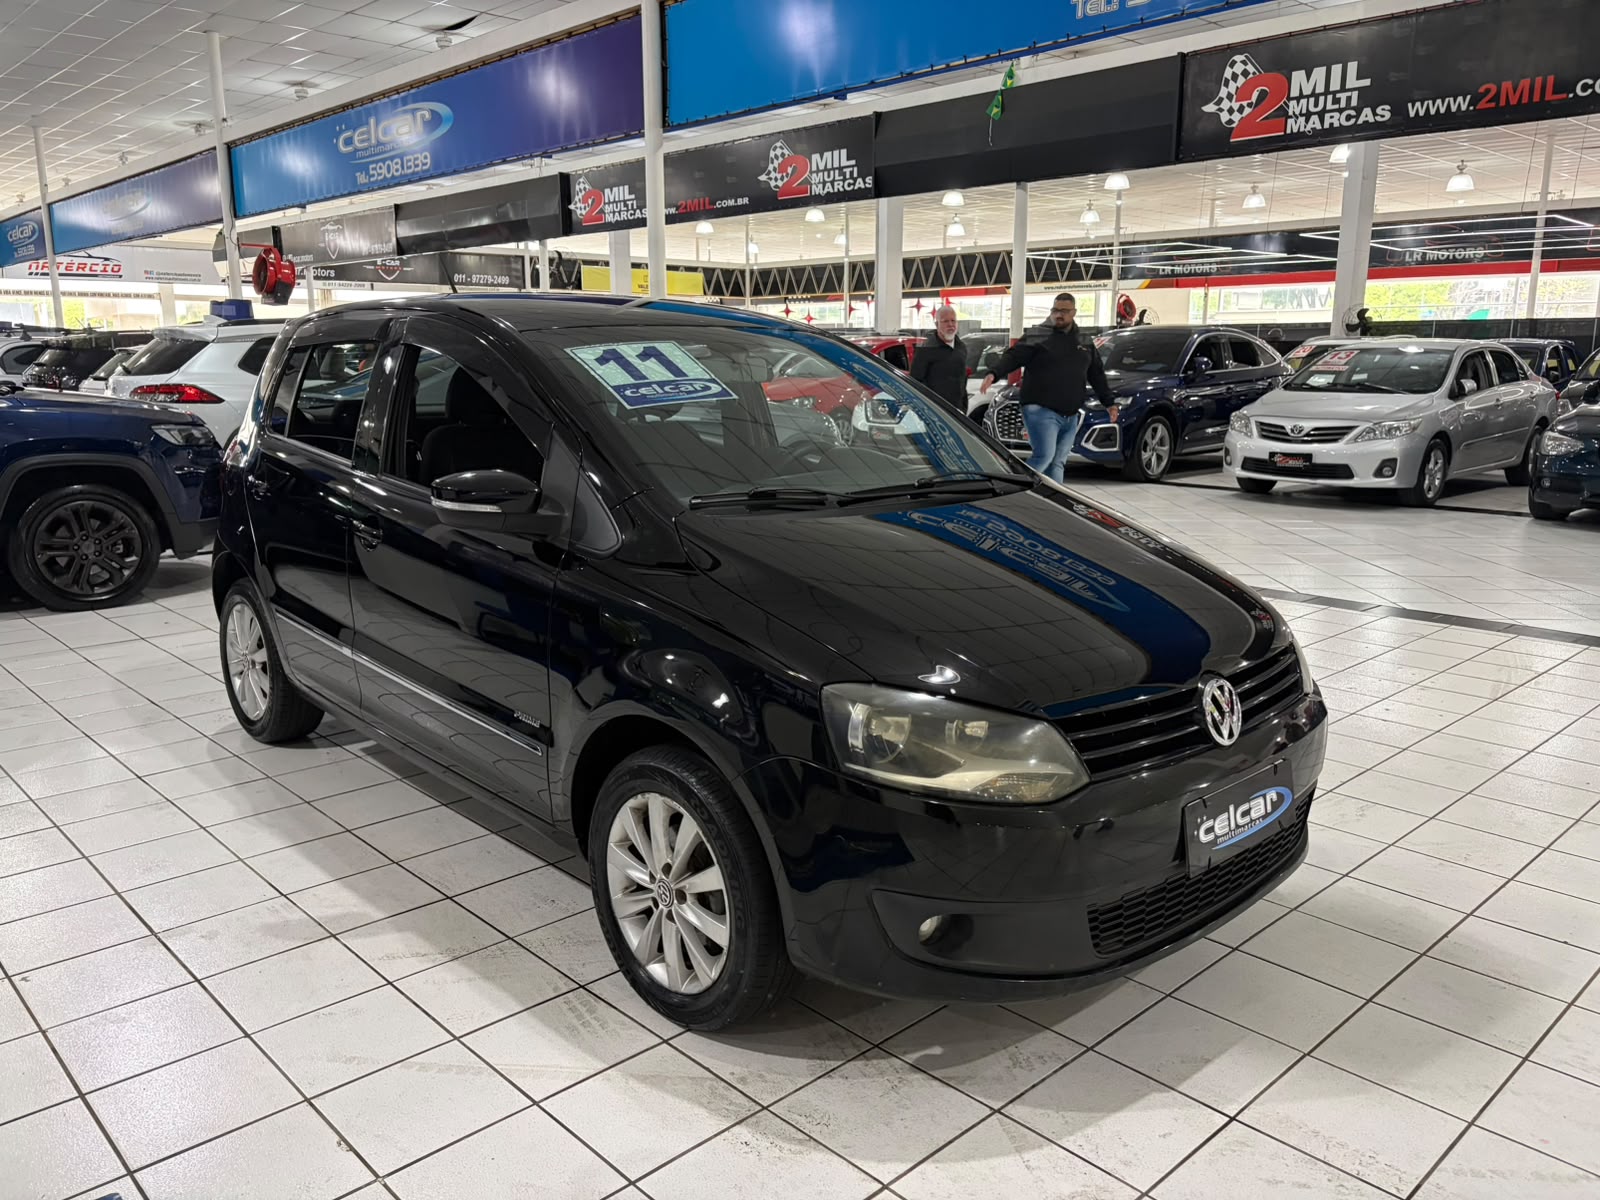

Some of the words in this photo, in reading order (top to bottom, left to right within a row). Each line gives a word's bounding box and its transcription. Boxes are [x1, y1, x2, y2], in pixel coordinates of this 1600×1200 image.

[1289, 61, 1371, 98] MIL
[1230, 72, 1289, 142] 2
[1288, 90, 1359, 116] MULTI
[1286, 104, 1391, 135] MARCAS
[368, 151, 431, 182] 5908.1339
[811, 148, 856, 171] MIL
[776, 154, 810, 200] 2
[811, 166, 858, 183] MULTI
[811, 175, 873, 196] MARCAS
[604, 184, 635, 202] MIL
[581, 188, 604, 226] 2
[604, 199, 637, 214] MULTI
[604, 208, 648, 225] MARCAS
[1404, 251, 1424, 263] LR
[1426, 247, 1486, 261] MOTORS
[453, 273, 466, 283] 011
[1174, 262, 1218, 275] MOTORS
[593, 345, 689, 382] 11
[1198, 789, 1278, 845] celcar
[1216, 817, 1264, 844] multimarcas
